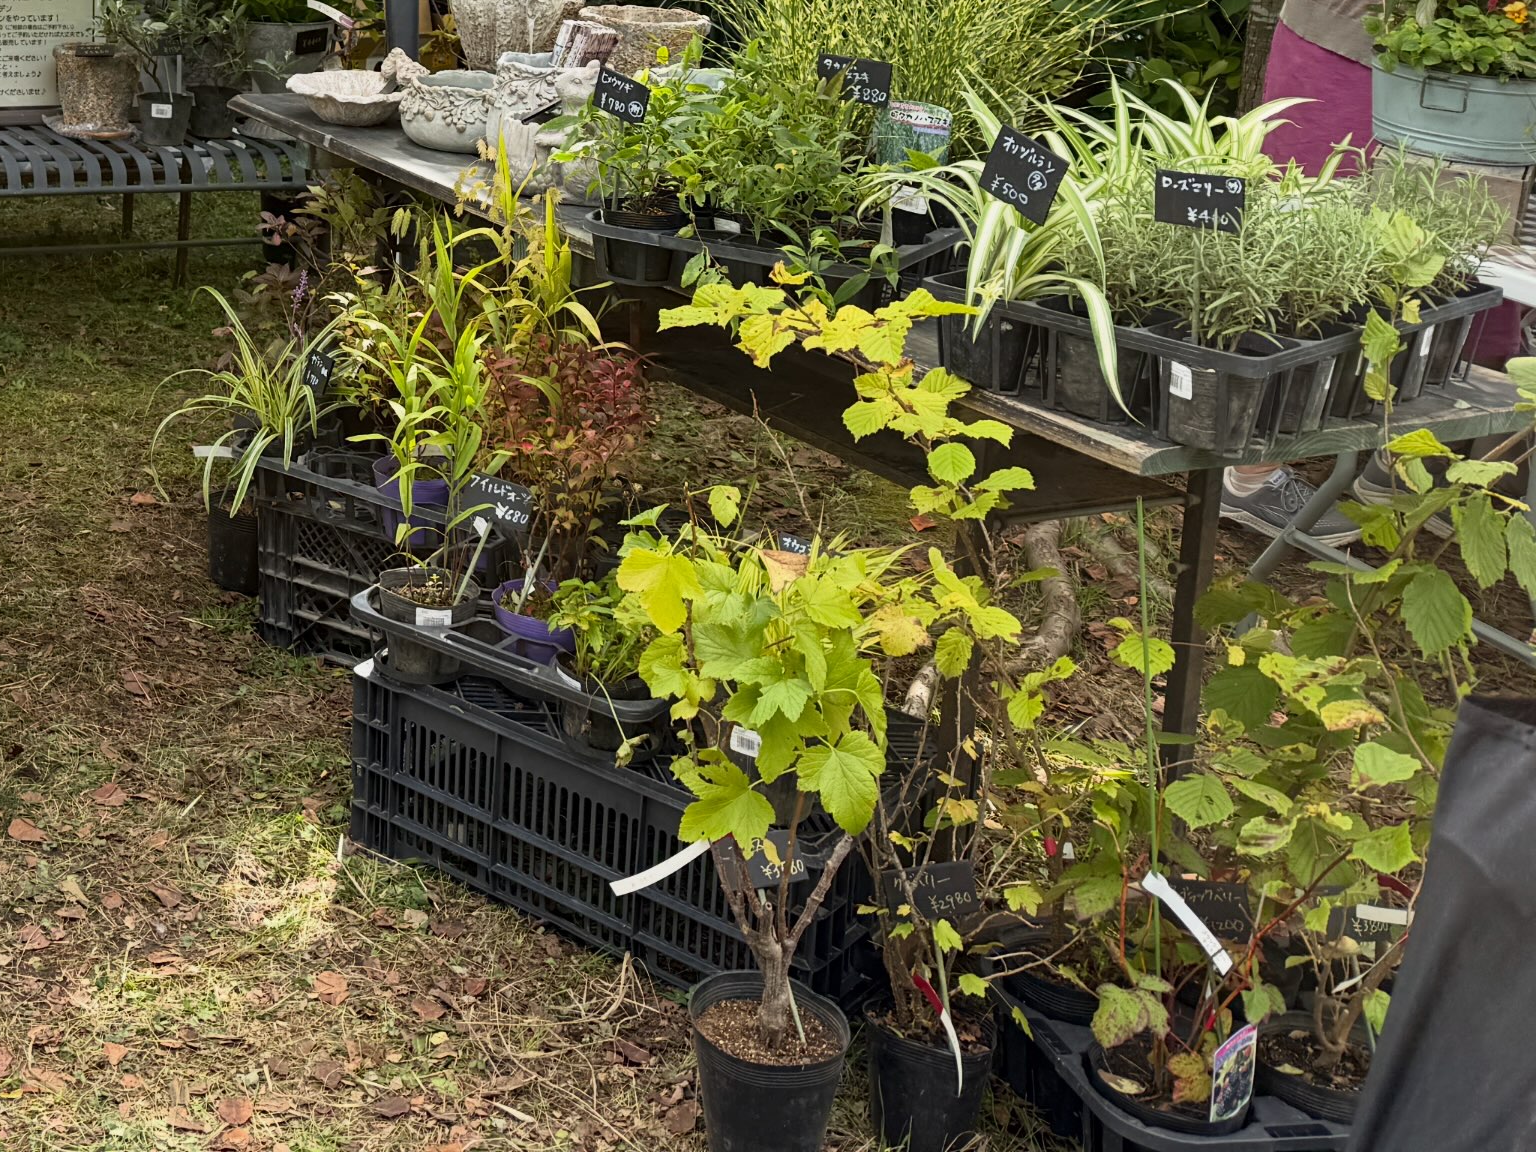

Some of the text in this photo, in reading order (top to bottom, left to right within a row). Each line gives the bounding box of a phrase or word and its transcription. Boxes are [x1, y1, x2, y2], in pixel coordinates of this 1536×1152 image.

[602, 71, 634, 93] ヒメウツギ
[600, 92, 626, 113] ¥780
[853, 85, 887, 103] ¥880
[990, 174, 1029, 205] ¥500
[1188, 206, 1229, 225] ¥40
[495, 501, 529, 524] ¥680
[928, 891, 972, 914] ¥2980
